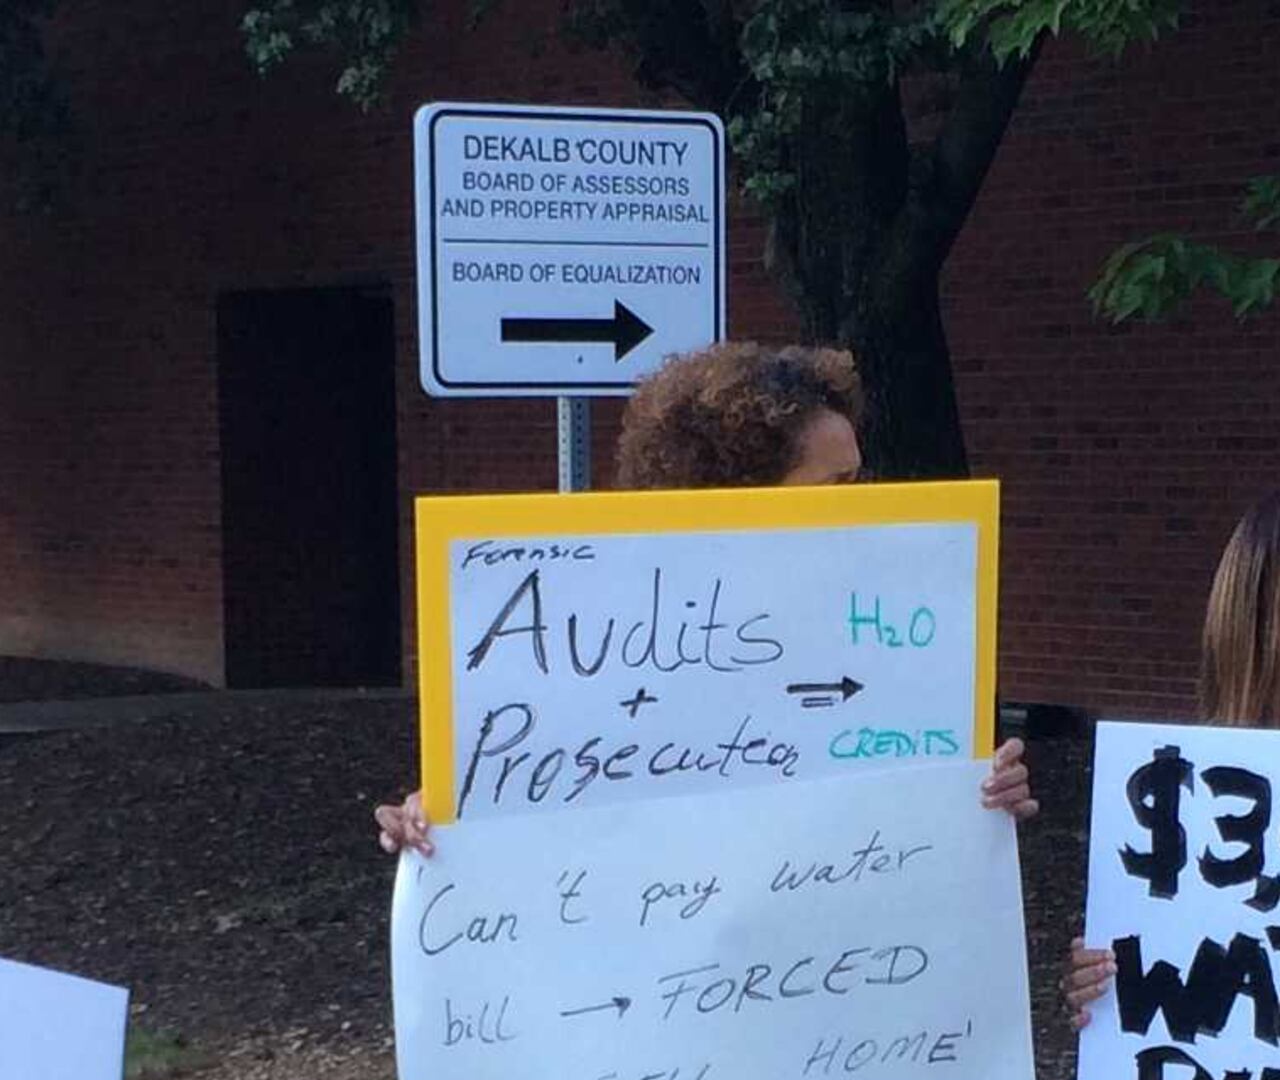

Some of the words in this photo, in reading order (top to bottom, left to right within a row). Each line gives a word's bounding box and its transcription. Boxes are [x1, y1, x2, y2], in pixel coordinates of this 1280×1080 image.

[463, 135, 570, 163] DEKALB
[578, 139, 689, 166] COUNTY
[462, 172, 534, 192] BOARD
[540, 174, 567, 192] OF
[572, 175, 690, 196] ASSESSORS
[441, 198, 484, 218] AND
[490, 200, 597, 220] PROPERTY
[602, 202, 710, 223] APPRAISAL
[452, 262, 524, 282] BOARD
[530, 263, 557, 282] OF
[562, 264, 701, 285] EQUALIZATION
[461, 539, 596, 570] Forensic
[467, 567, 784, 676] Audits
[640, 879, 721, 927] pay
[770, 830, 934, 893] water
[658, 945, 929, 1022] FORCED
